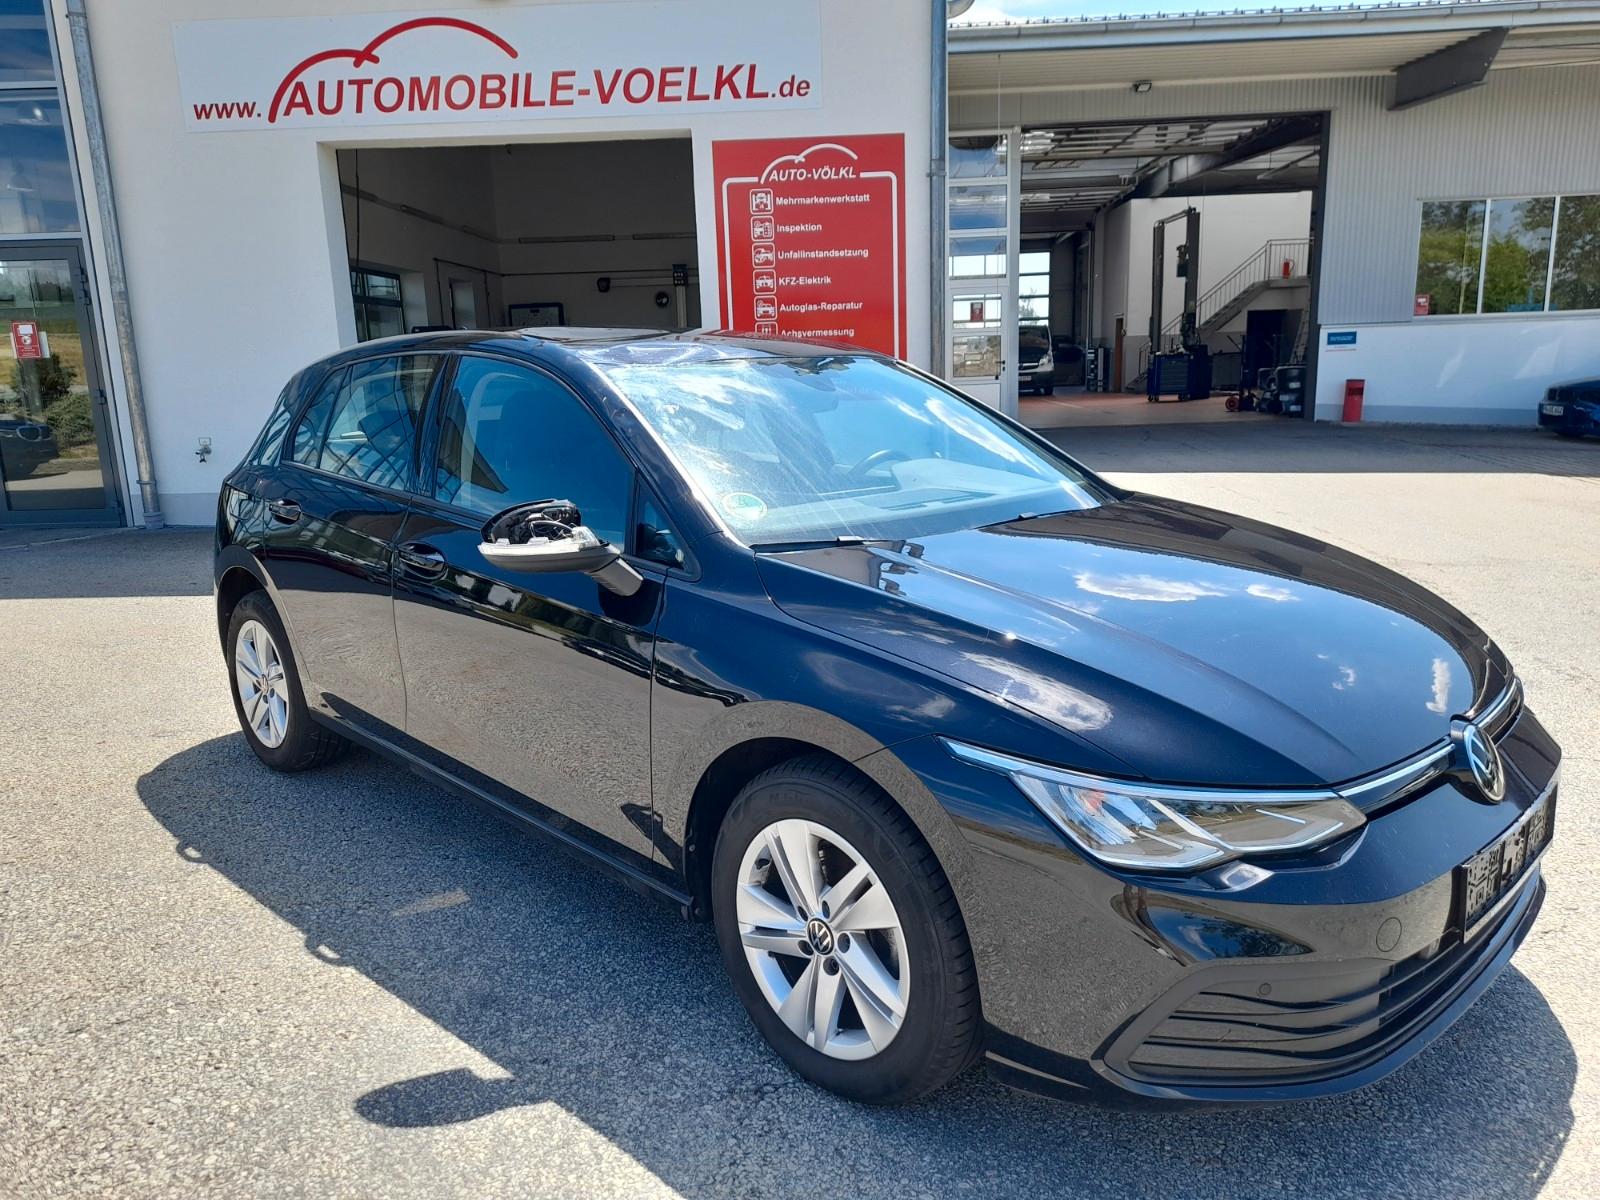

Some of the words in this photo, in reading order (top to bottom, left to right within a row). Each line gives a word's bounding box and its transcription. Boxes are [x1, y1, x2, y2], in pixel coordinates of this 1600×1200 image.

[768, 165, 857, 182] AUTO-VÖLKL
[775, 193, 870, 206] Mehrmarkenwerkstatt
[776, 223, 823, 234] Inspektion
[777, 248, 869, 260] Unfallinstandsetzung
[778, 275, 832, 286] KFZ-Elektrik
[779, 301, 863, 313] Autoglas-Reparatur
